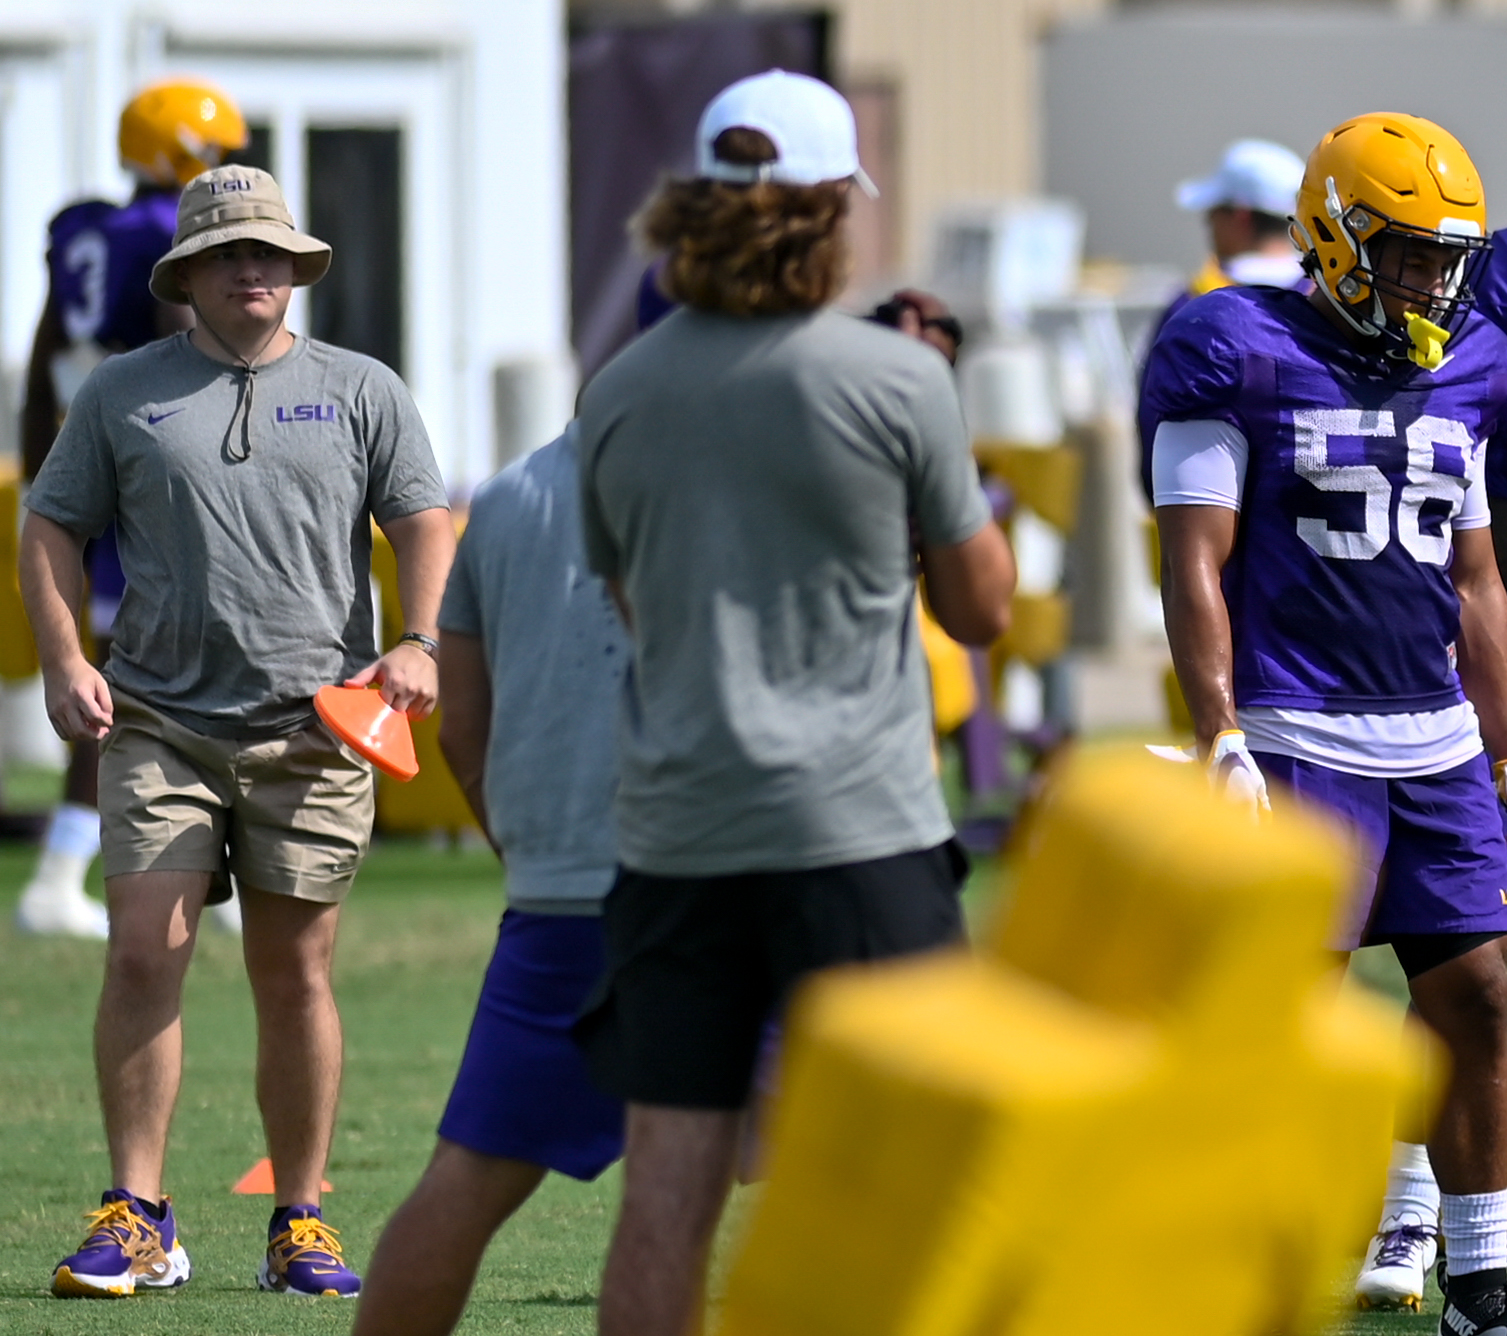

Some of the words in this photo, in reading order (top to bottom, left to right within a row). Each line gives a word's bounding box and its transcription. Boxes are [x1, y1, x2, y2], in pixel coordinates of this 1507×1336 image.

[209, 180, 252, 196] LSU
[276, 404, 335, 423] LSU
[1292, 408, 1475, 566] 58
